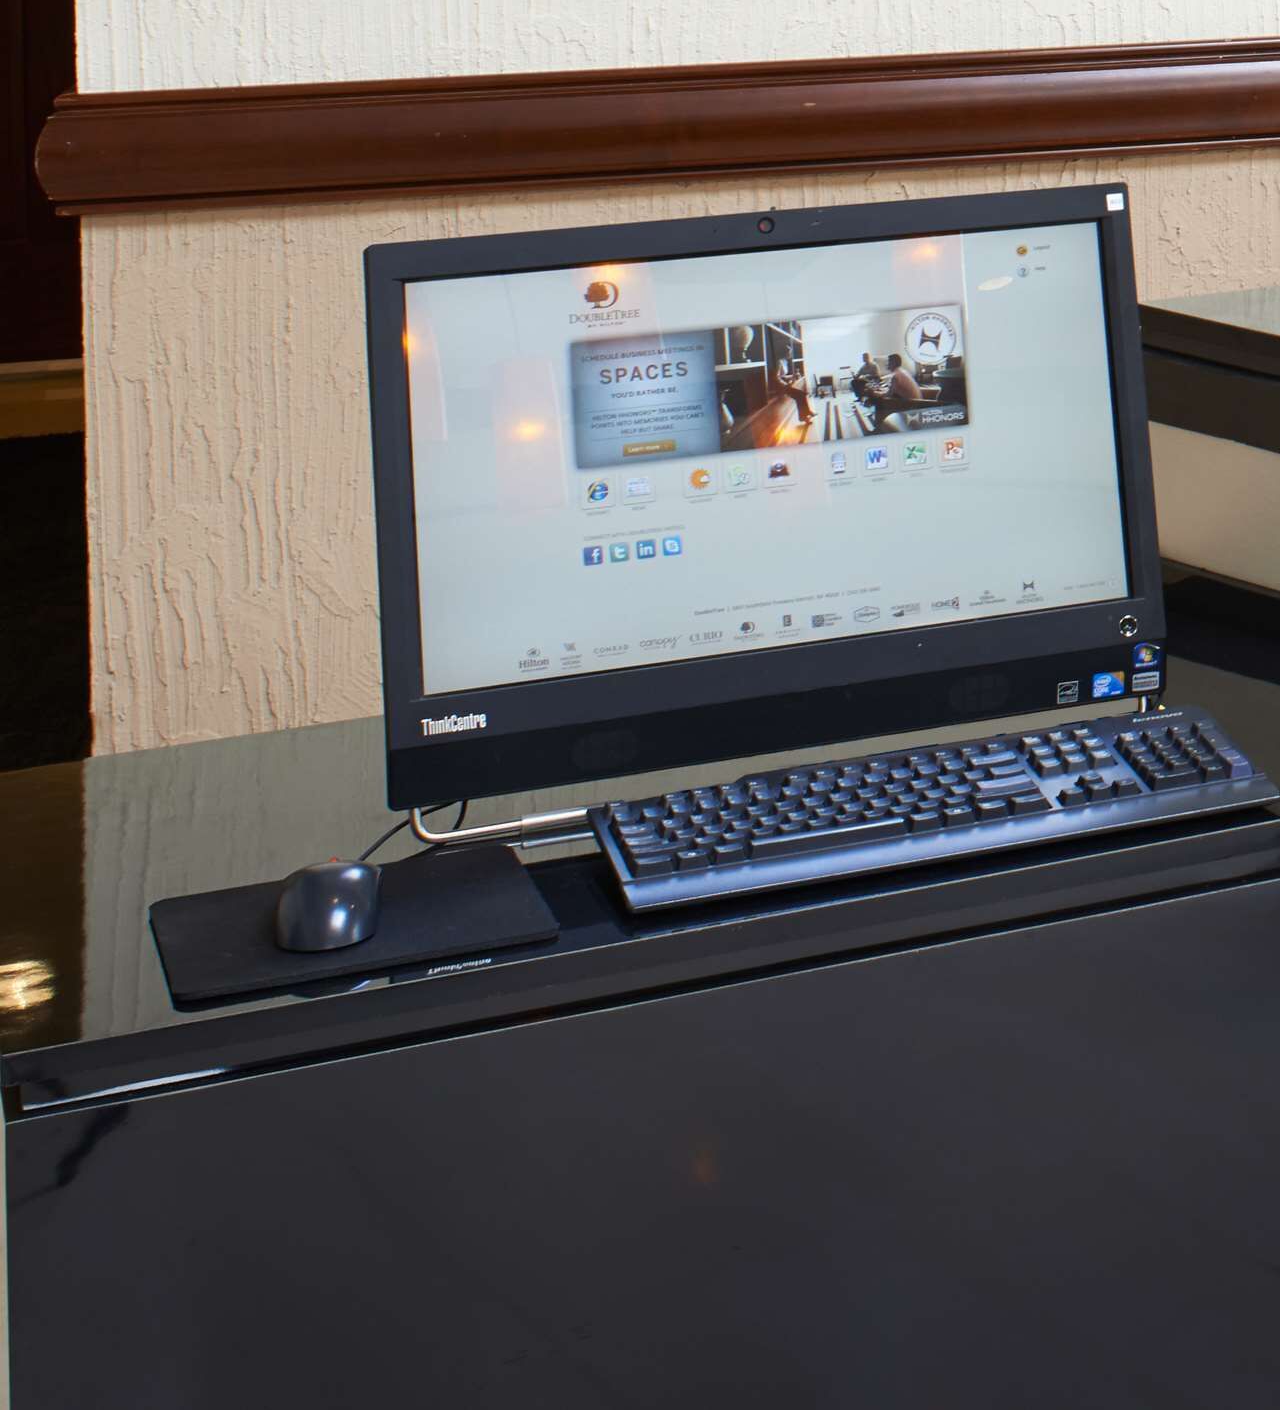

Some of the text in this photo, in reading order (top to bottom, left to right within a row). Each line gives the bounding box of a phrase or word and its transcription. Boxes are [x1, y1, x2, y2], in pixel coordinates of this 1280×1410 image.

[600, 360, 689, 385] SPACES
[518, 658, 550, 669] Hilton
[420, 712, 487, 736] ThinkCentre
